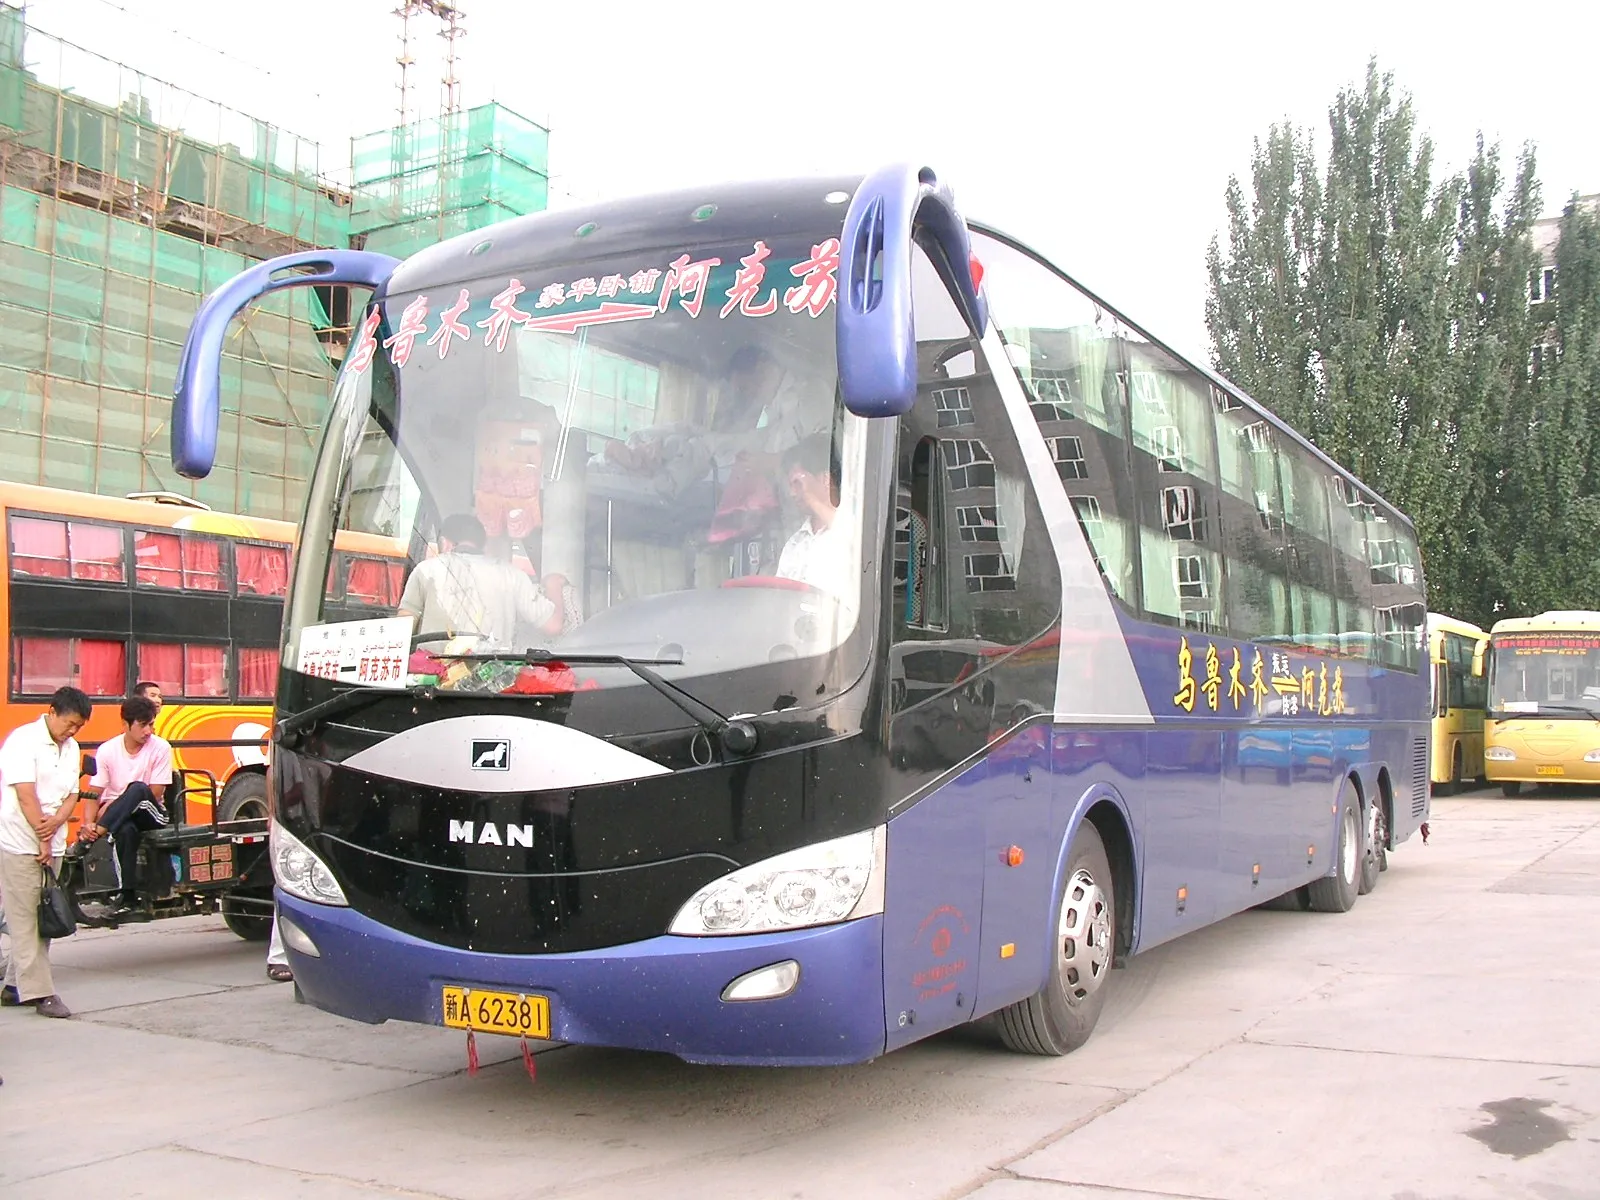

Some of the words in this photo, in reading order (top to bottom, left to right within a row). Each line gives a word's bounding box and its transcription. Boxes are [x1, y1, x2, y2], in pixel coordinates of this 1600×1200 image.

[344, 277, 532, 374] 乌鲁木齐
[535, 268, 661, 308] 豪华卧铺
[657, 238, 841, 318] 阿克苏
[358, 655, 402, 682] 阿克苏市
[1173, 634, 1269, 714] 乌鲁木齐
[1301, 661, 1345, 716] 阿克苏
[449, 819, 534, 848] MAN
